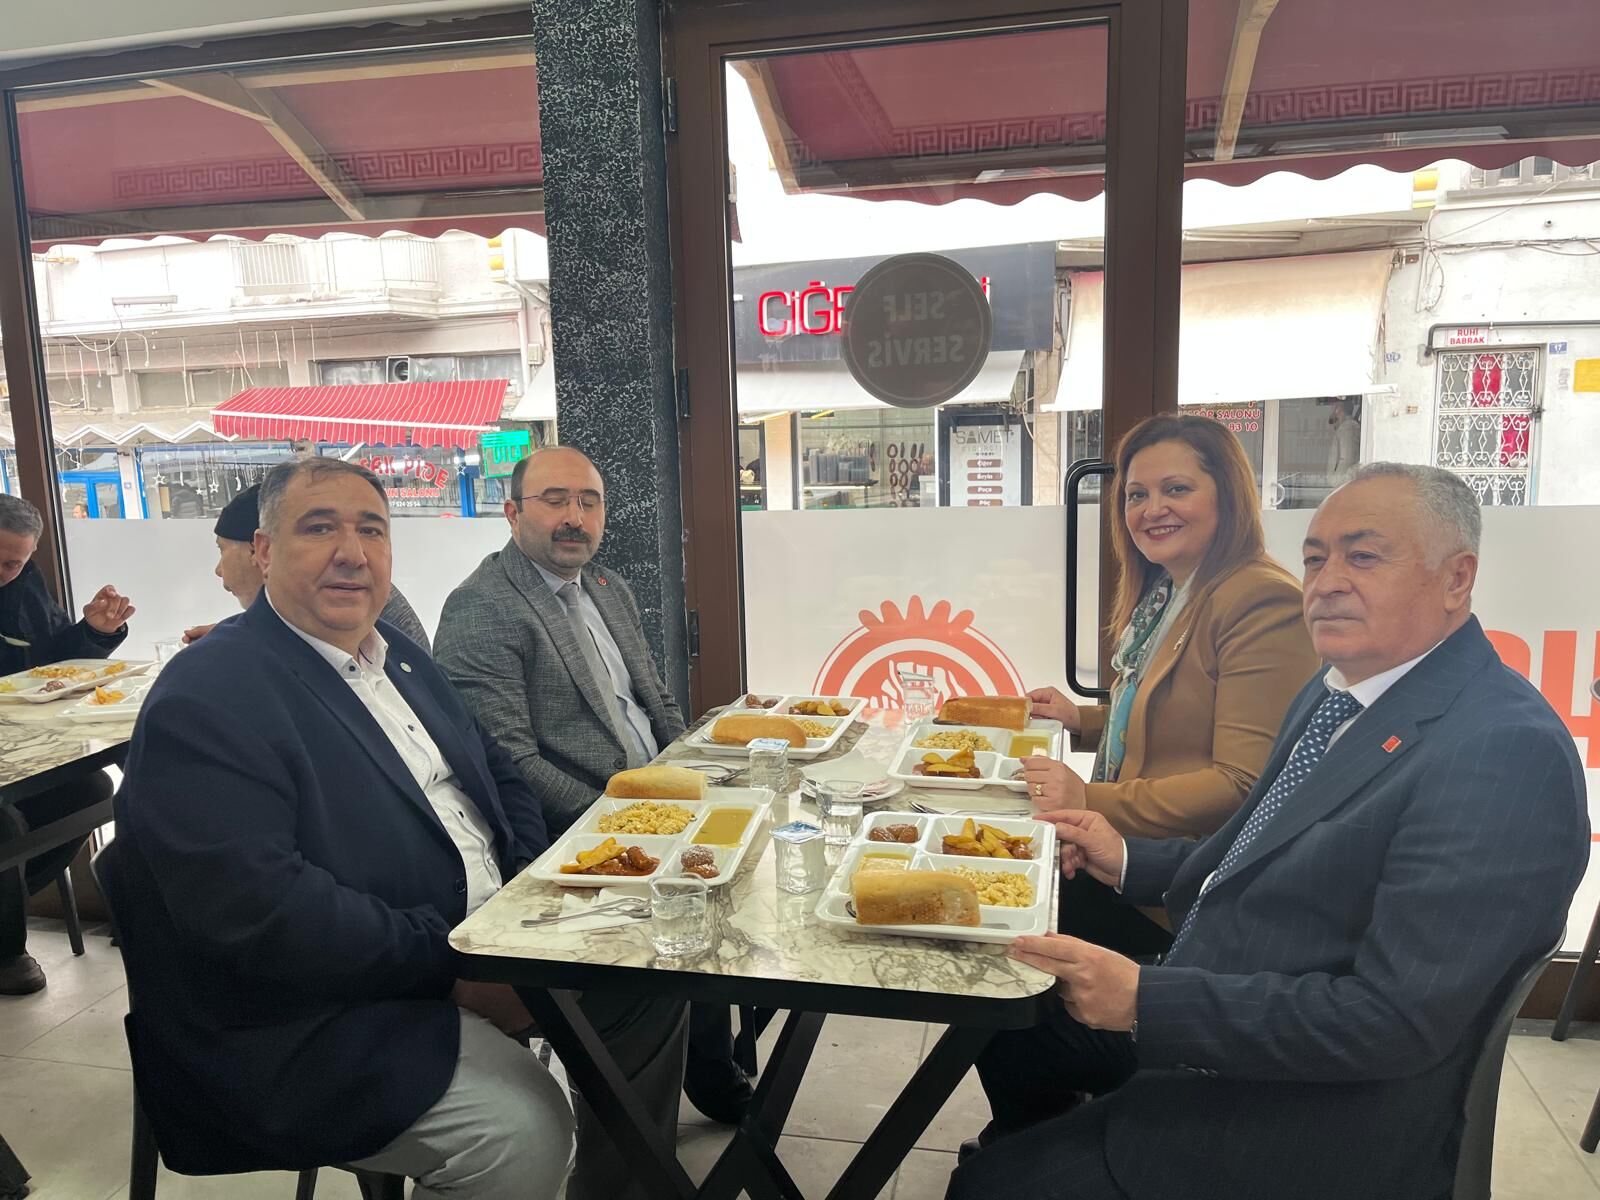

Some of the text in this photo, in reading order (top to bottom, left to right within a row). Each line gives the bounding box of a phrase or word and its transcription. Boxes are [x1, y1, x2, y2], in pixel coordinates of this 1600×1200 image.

[1217, 408, 1261, 420] SALONU
[956, 430, 1012, 444] SAMET
[403, 455, 449, 489] PİDE
[400, 487, 441, 498] SALONU
